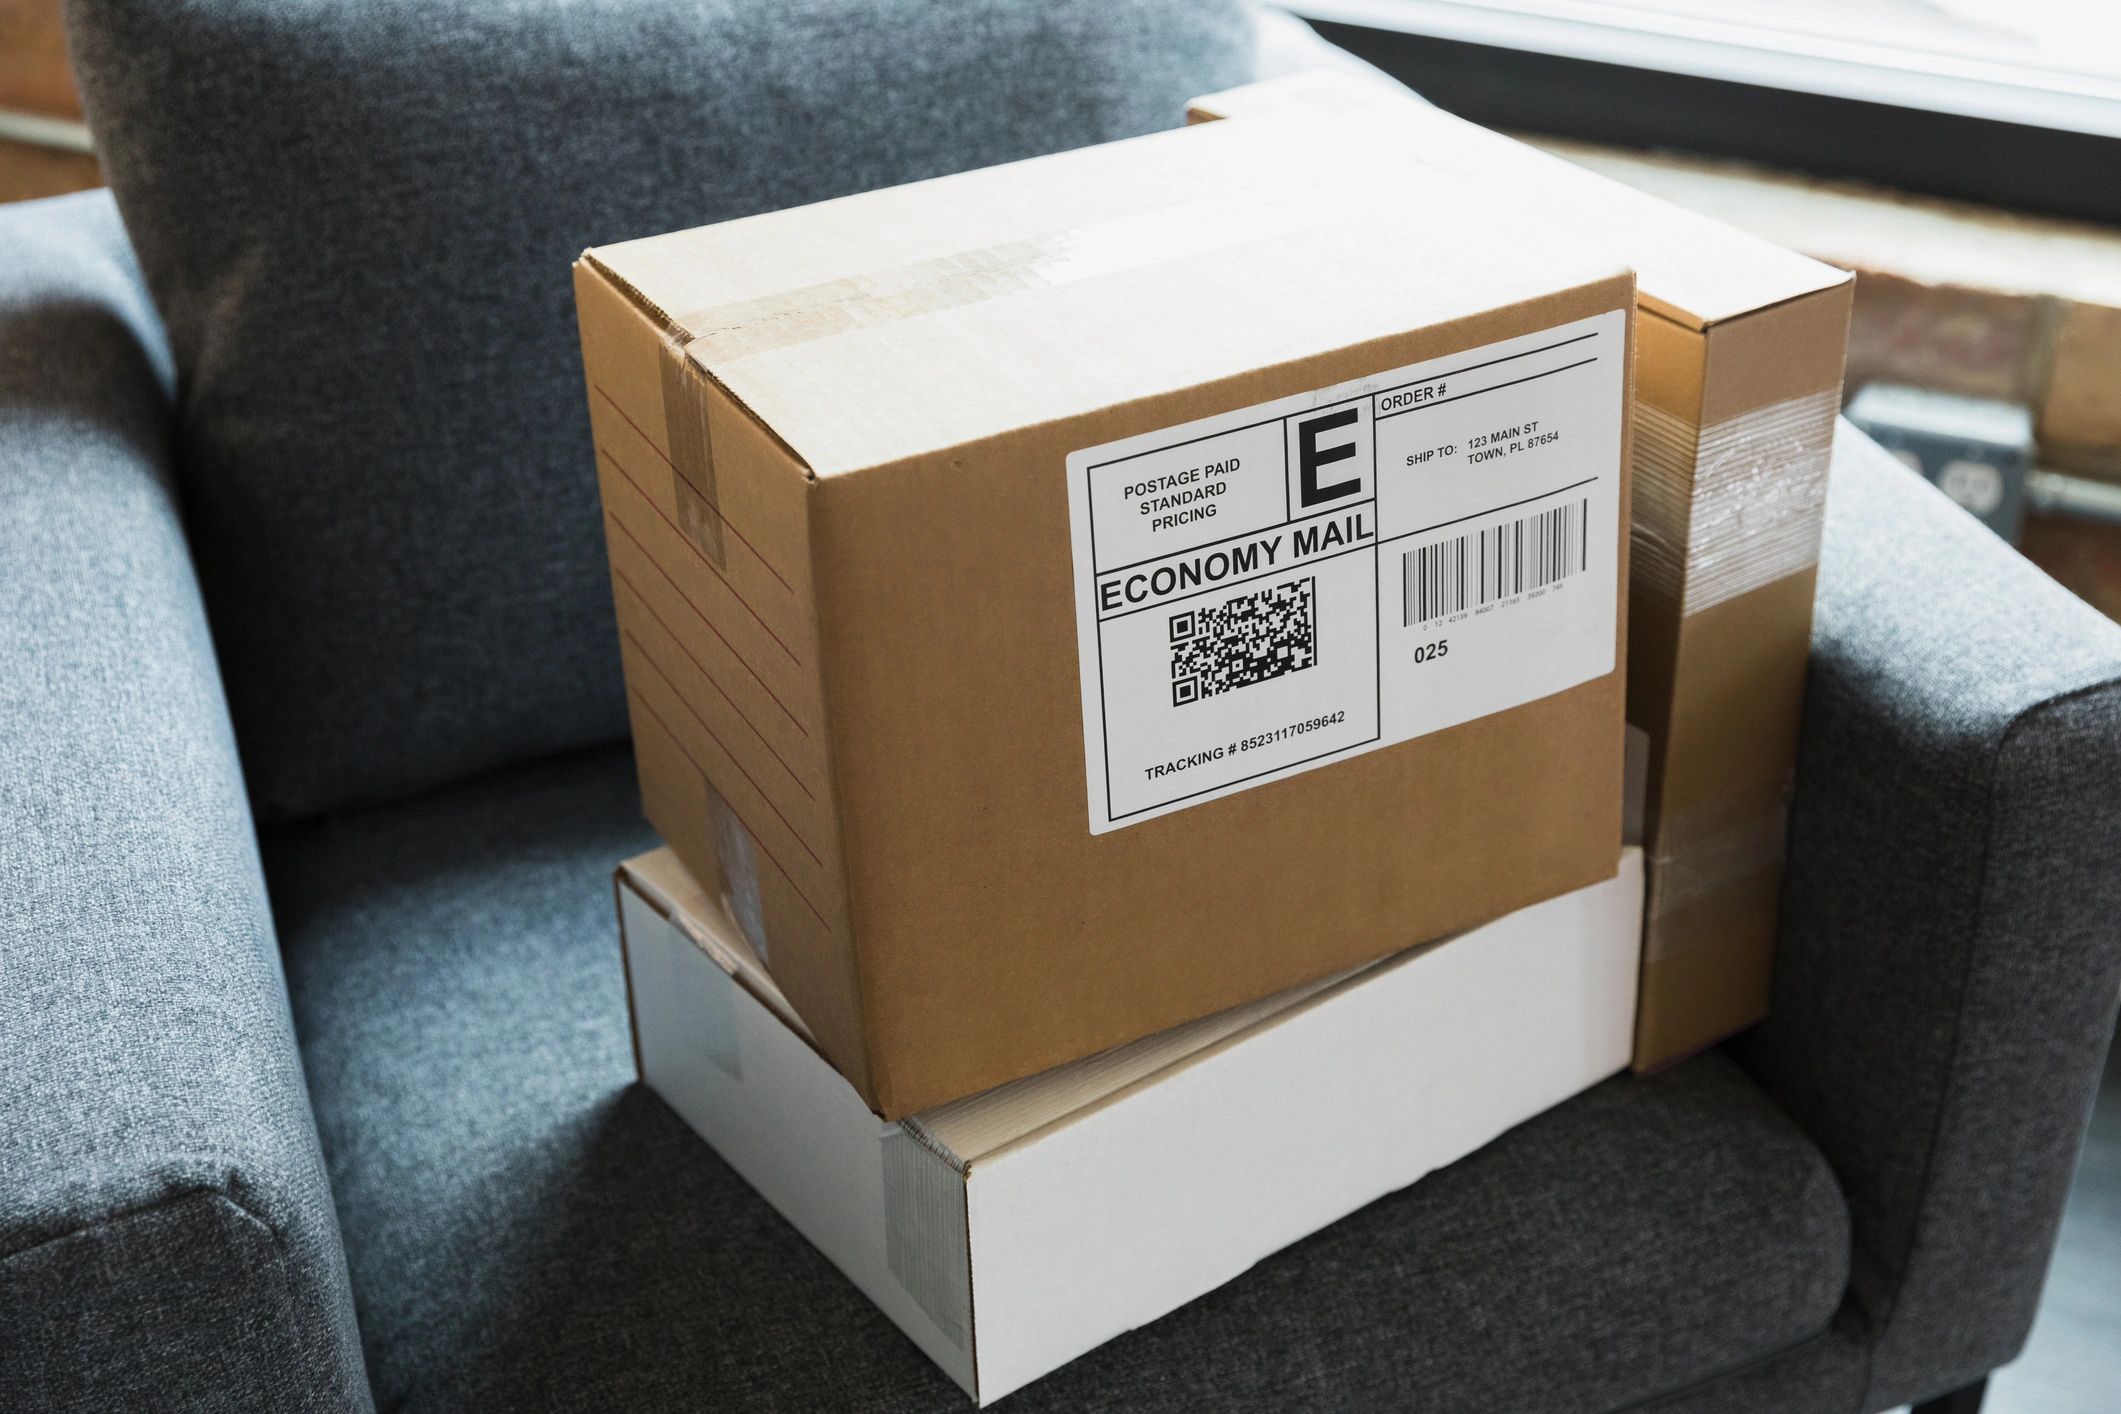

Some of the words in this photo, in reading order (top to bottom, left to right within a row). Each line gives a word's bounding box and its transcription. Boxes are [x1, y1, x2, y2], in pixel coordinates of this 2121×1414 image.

[1381, 387, 1434, 411] ORDER
[1438, 383, 1447, 397] #
[1468, 437, 1487, 449] 123
[1491, 426, 1520, 444] MAIN
[1524, 421, 1539, 435] ST
[1468, 446, 1507, 465] TOWN,
[1510, 440, 1524, 453] PL
[1528, 431, 1559, 449] 87654
[1299, 408, 1361, 508] E
[1407, 450, 1434, 466] SHIP
[1437, 445, 1457, 459] TO:
[1125, 468, 1200, 499] POSTAGE
[1205, 458, 1240, 478] PAID
[1141, 482, 1227, 515] STANDARD
[1153, 504, 1217, 532] PRICING
[1101, 536, 1282, 611] ECONOMY
[1294, 514, 1374, 558] MAIL
[1415, 640, 1448, 663] 025
[1145, 747, 1224, 780] TRACKING
[1228, 743, 1237, 757] #
[1241, 711, 1345, 751] 8523117059642
